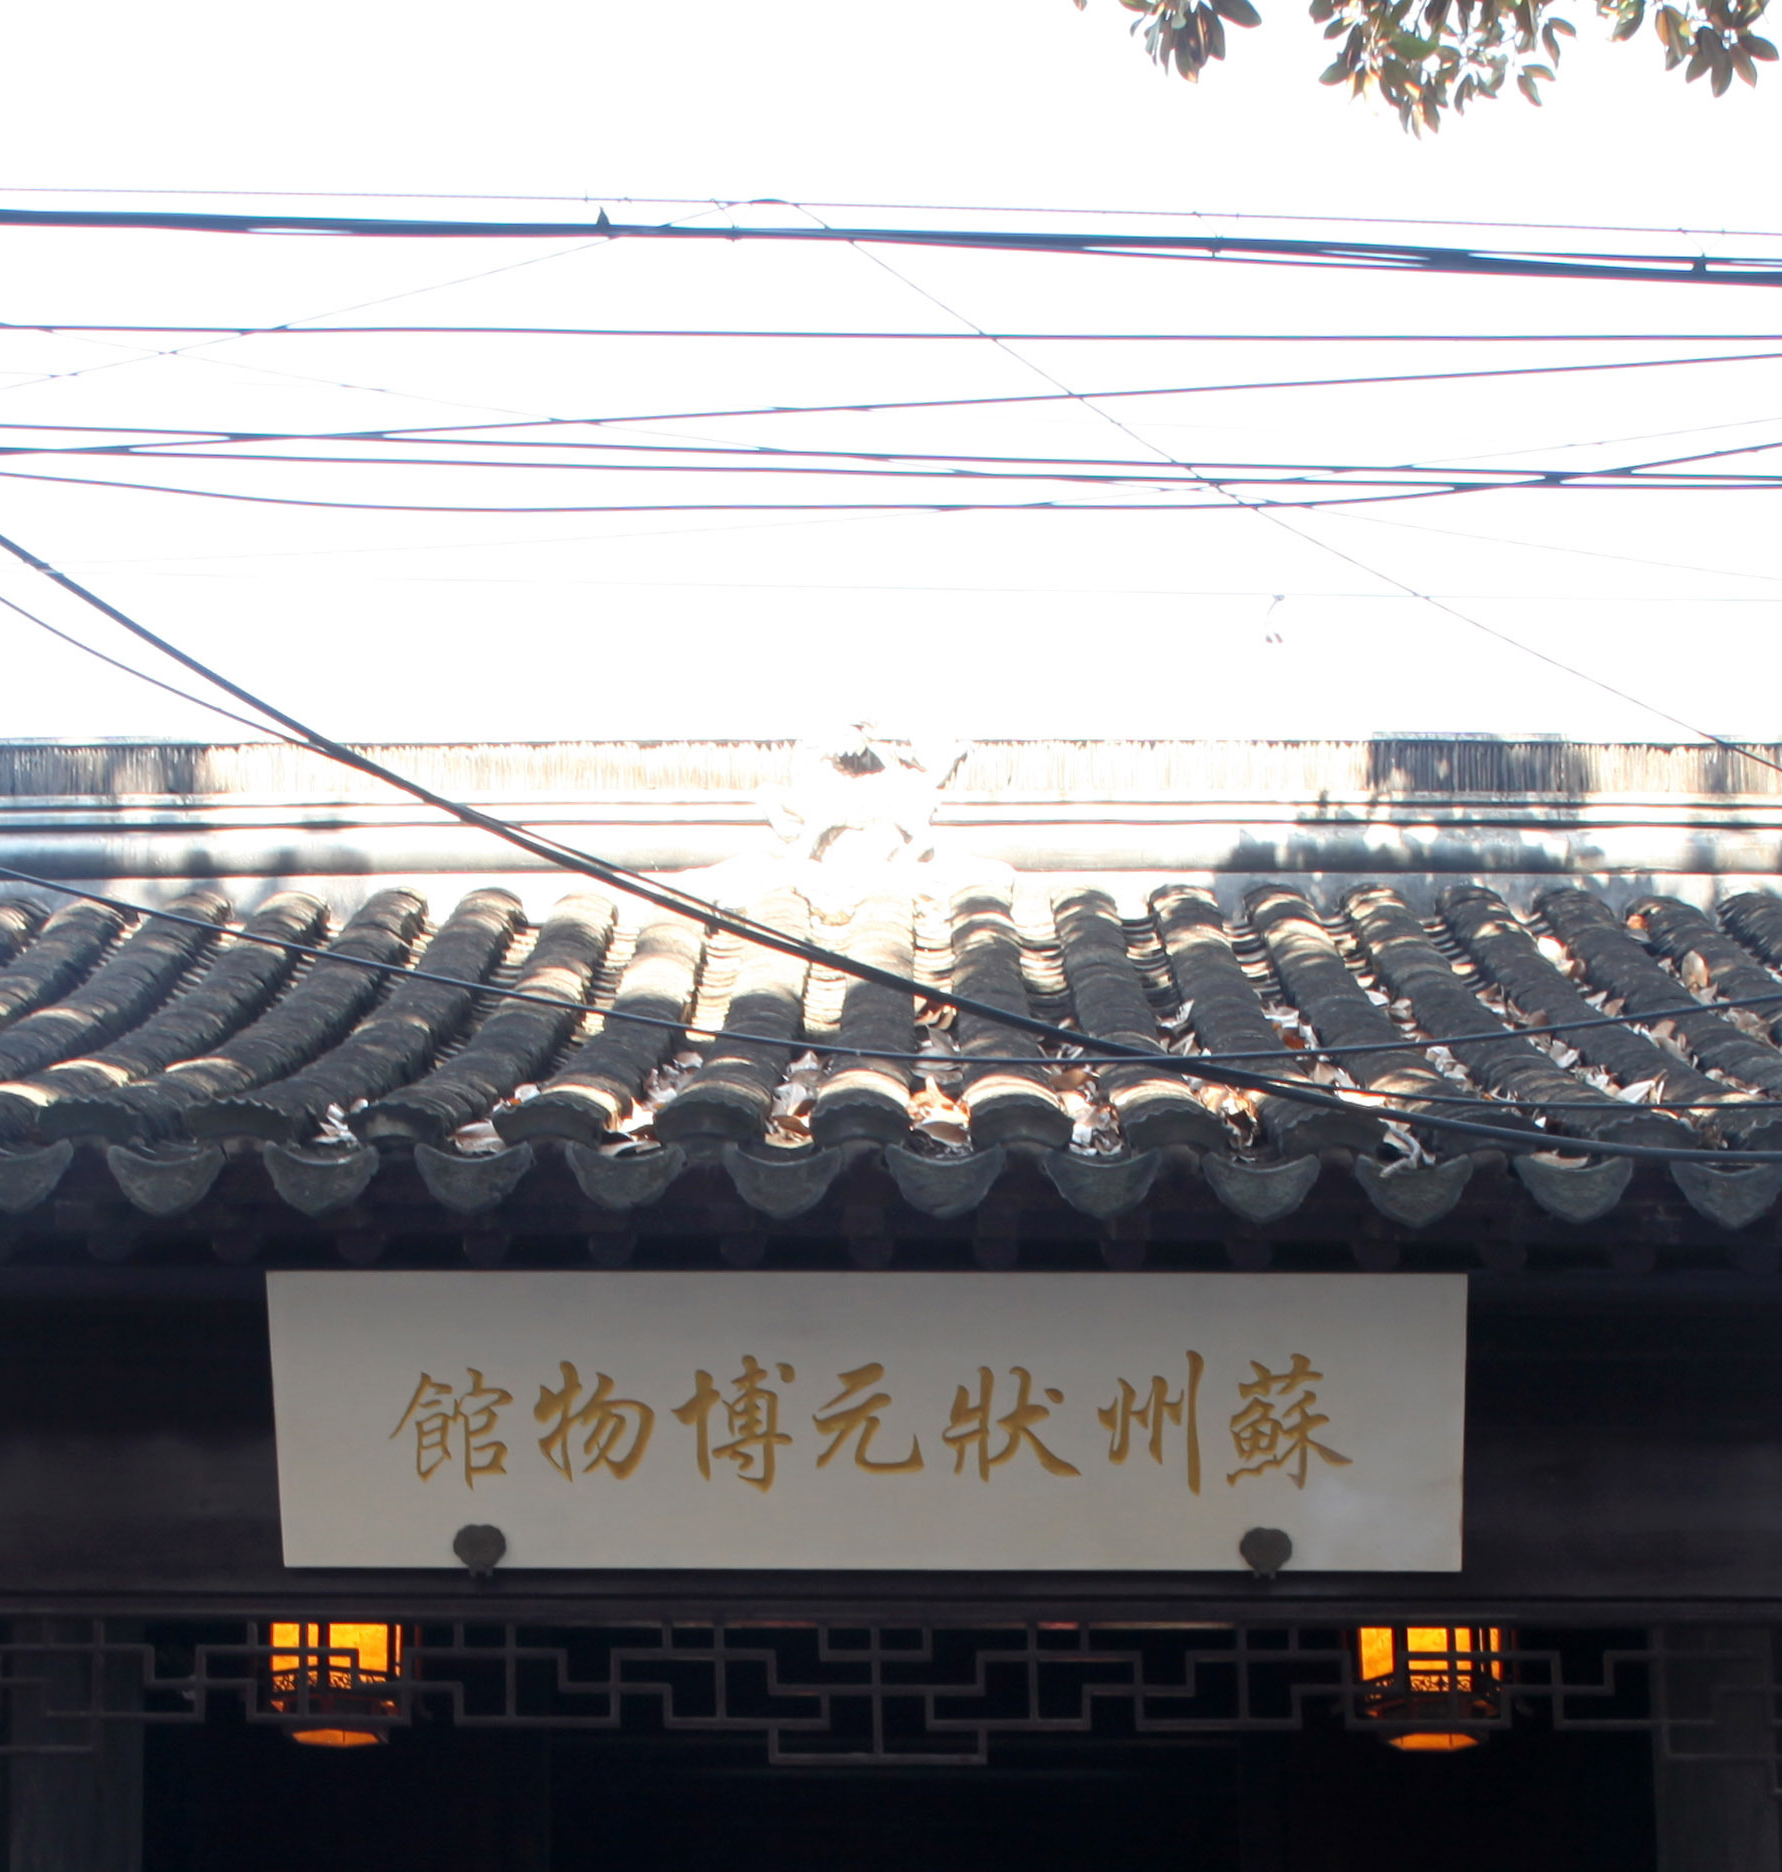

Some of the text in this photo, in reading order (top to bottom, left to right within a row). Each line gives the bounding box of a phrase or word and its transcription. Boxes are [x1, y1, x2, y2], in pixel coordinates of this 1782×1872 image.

[389, 1350, 1354, 1494] 蘇州狀元博物館
